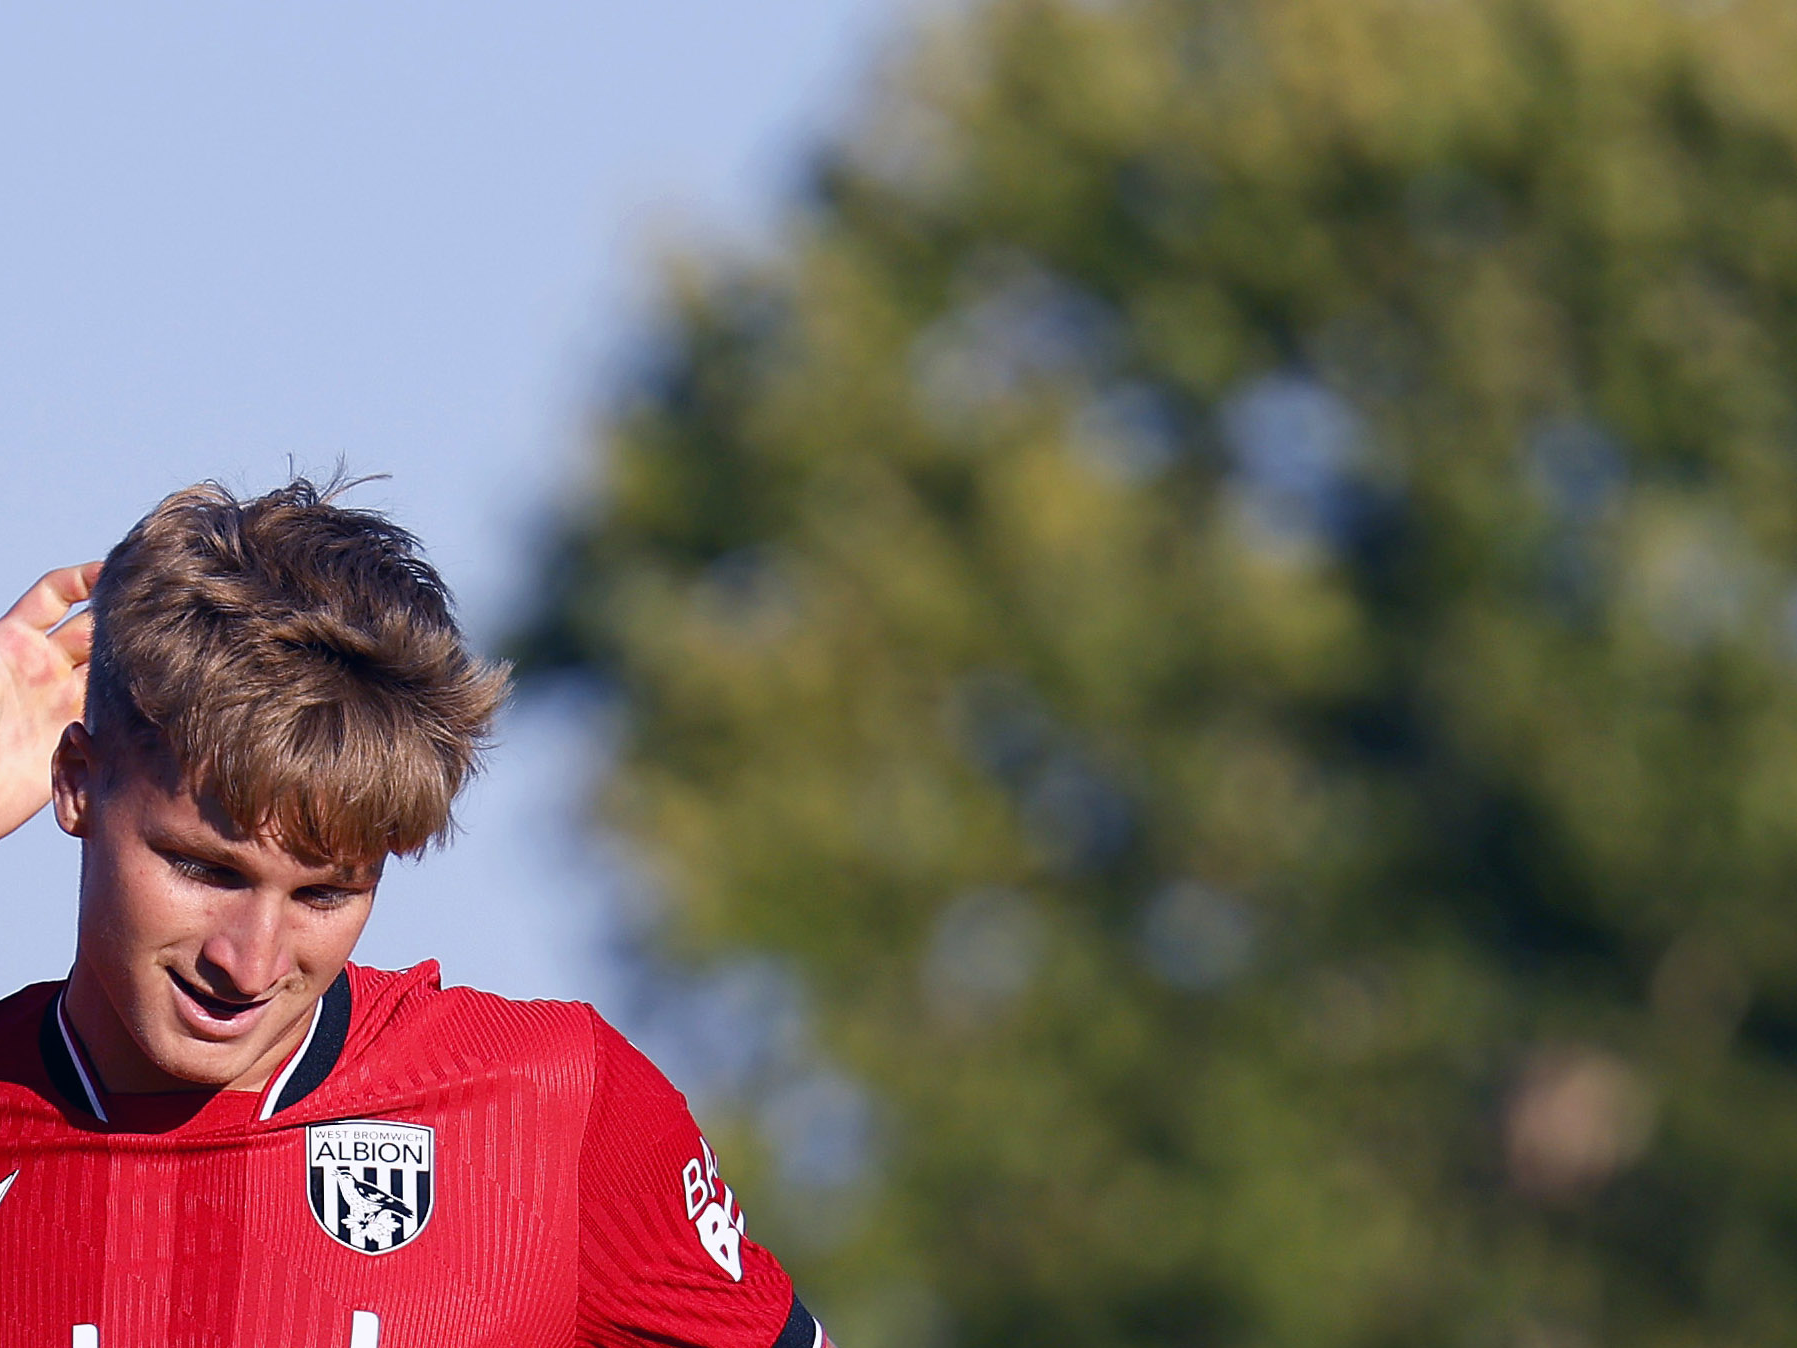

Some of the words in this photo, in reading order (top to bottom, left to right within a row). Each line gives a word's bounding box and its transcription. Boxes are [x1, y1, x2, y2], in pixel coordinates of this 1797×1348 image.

[314, 1130, 349, 1139] WEST
[353, 1131, 423, 1142] BROMWICH
[315, 1141, 423, 1164] ALBION
